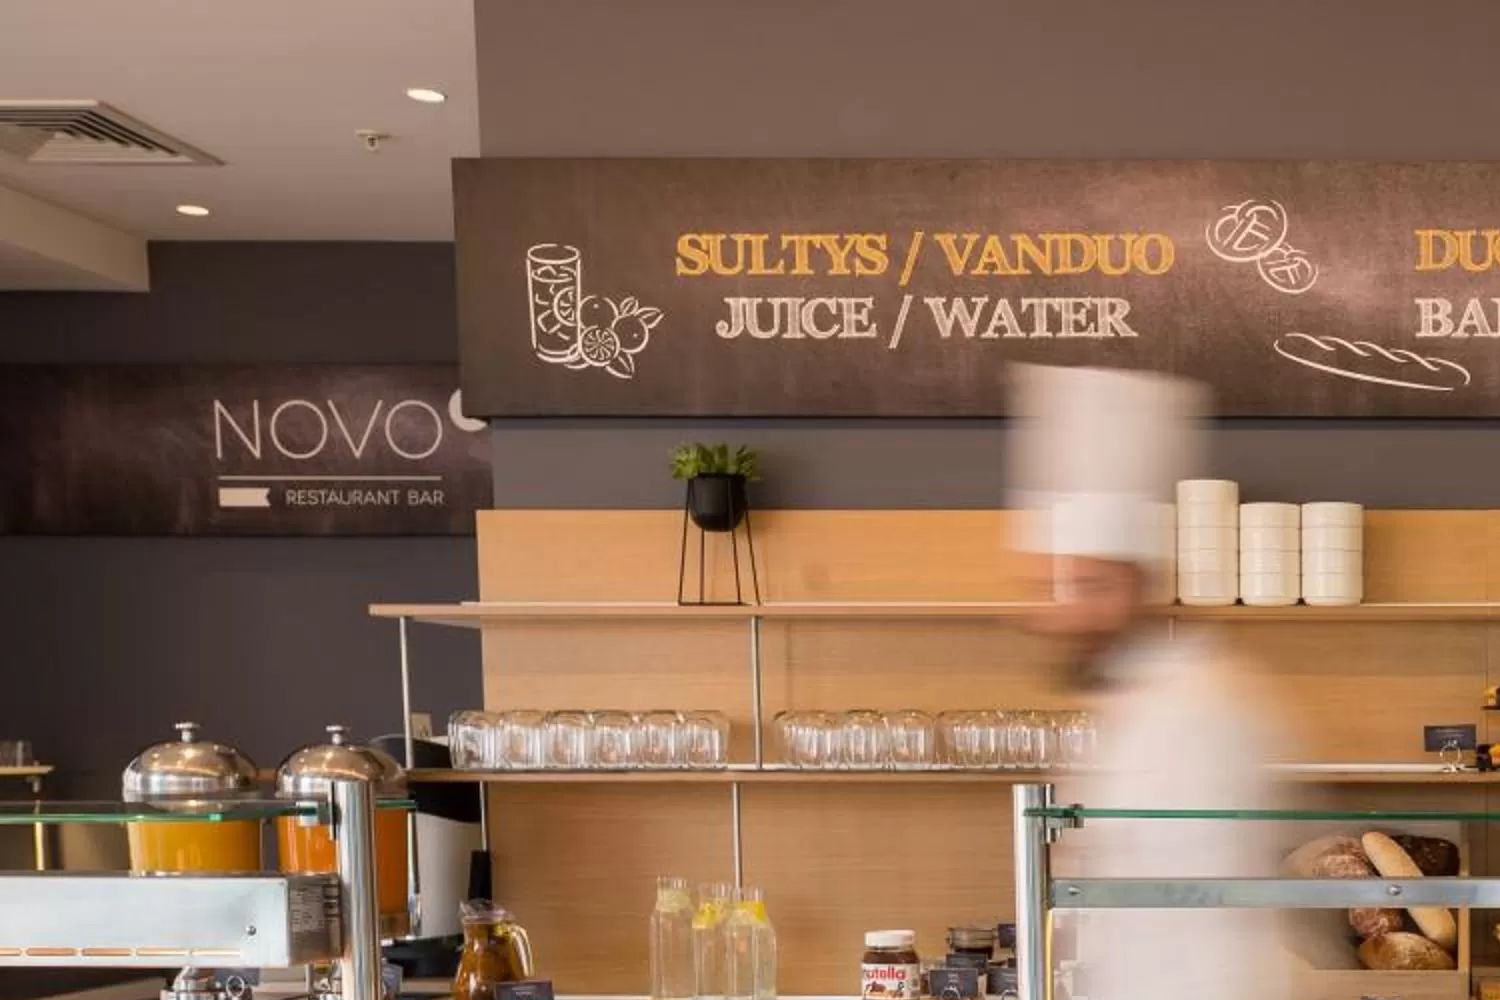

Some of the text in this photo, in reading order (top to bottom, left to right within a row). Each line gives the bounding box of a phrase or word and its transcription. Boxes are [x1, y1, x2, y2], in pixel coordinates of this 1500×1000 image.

[675, 232, 888, 276] SULTYS
[934, 232, 1175, 276] VANDUO
[715, 297, 876, 339] JUICE
[924, 297, 1138, 339] WATER
[285, 488, 444, 506] RESTAURANT BAR
